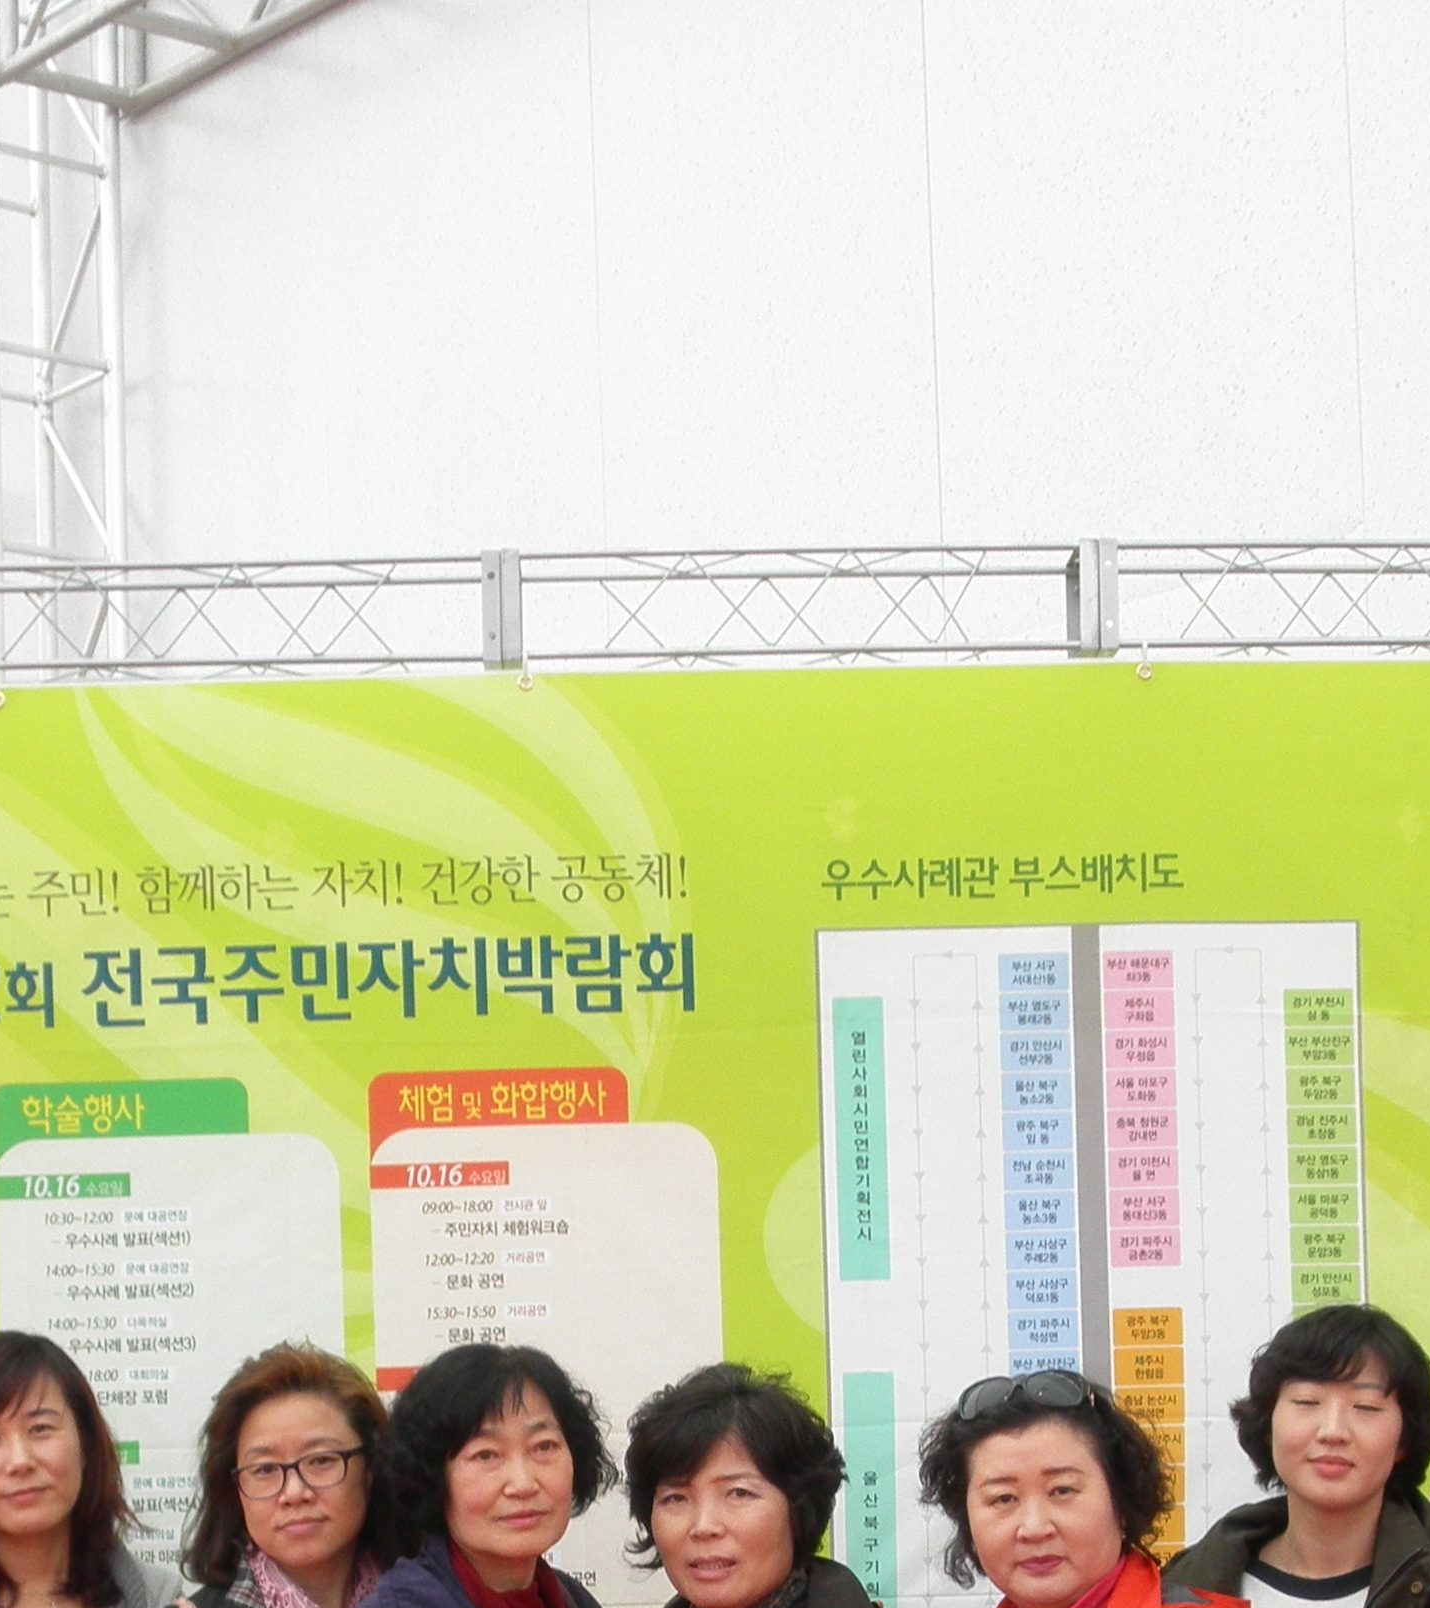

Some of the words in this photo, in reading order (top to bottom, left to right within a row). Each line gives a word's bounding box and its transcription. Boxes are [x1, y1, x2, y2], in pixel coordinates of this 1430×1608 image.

[821, 856, 999, 901] 우수사례관
[1010, 852, 1184, 897] 부스배치도
[27, 867, 119, 917] 주민!
[136, 862, 300, 915] 함께하는
[312, 859, 403, 907] 자치!
[421, 854, 540, 906] 건강한
[551, 852, 687, 903] 공동체!
[1012, 961, 1032, 972] 부산
[1036, 960, 1055, 971] 서구
[1107, 959, 1126, 970] 부산
[1130, 958, 1170, 969] 해운대구
[81, 932, 695, 1028] 전국주민자치박람회
[1008, 1001, 1028, 1012] 부산
[1293, 998, 1312, 1008] 경기
[1010, 1041, 1028, 1052] 경기
[1115, 1038, 1133, 1049] 경기
[1138, 1038, 1167, 1049] 화성시
[1289, 1037, 1308, 1047] 부산
[1015, 1081, 1034, 1092] 울산
[1038, 1080, 1058, 1092] 북구
[1115, 1078, 1134, 1088] 서울
[399, 1084, 453, 1122] 체험
[462, 1091, 482, 1119] 및
[491, 1079, 607, 1119] 화합행사
[22, 1093, 145, 1134] 학술행사
[1016, 1121, 1035, 1132] 광주
[1040, 1120, 1059, 1131] 북구
[1012, 1161, 1032, 1172] 전남
[1036, 1160, 1065, 1171] 순천시
[1118, 1158, 1137, 1168] 경기
[1296, 1155, 1316, 1166] 부산
[406, 1165, 462, 1187] 10.16
[469, 1170, 506, 1185] 수요일
[24, 1176, 80, 1198] 10.16
[86, 1181, 122, 1195] 수요일
[422, 1200, 493, 1214] 09:00~18:00
[504, 1200, 533, 1211] 전시관
[1018, 1201, 1038, 1212] 울산
[1042, 1200, 1061, 1211] 북구
[1123, 1197, 1142, 1208] 부산
[1147, 1197, 1166, 1207] 서구
[44, 1212, 113, 1225] 10:30~12:00
[1022, 1213, 1058, 1224] 농소3동
[445, 1222, 498, 1237] 주민자치
[503, 1219, 569, 1236] 체험워크숍
[66, 1233, 118, 1248] 우수사례
[123, 1231, 191, 1247] 발표(섹션1)
[1014, 1240, 1034, 1251] 부산
[1038, 1239, 1067, 1250] 사상구
[1120, 1237, 1138, 1248] 경기
[1142, 1236, 1172, 1247] 파주시
[1326, 1234, 1345, 1244] 북구
[425, 1252, 494, 1266] 12:00~12:20
[506, 1252, 545, 1264] 거리공연
[46, 1264, 115, 1277] 14:00~15:30
[446, 1275, 472, 1290] 문화
[478, 1273, 505, 1289] 공연
[1300, 1274, 1319, 1284] 경기
[1323, 1273, 1352, 1283] 안산시
[1016, 1280, 1034, 1291] 부산
[1039, 1279, 1068, 1289] 사상구
[67, 1285, 120, 1300] 우수사례
[125, 1283, 194, 1299] 발표(섹션2)
[428, 1306, 496, 1320] 15:30~15:50
[507, 1304, 547, 1316] 거리공연
[48, 1317, 116, 1330] 14:00~15:30
[1017, 1320, 1036, 1330] 경기
[1040, 1319, 1070, 1329] 파주시
[1127, 1317, 1146, 1327] 광주
[1150, 1316, 1169, 1326] 북구
[448, 1328, 474, 1343] 문화
[480, 1327, 506, 1342] 공연
[70, 1338, 121, 1354] 우수사례
[127, 1336, 196, 1352] 발표(섹션3)
[1013, 1359, 1033, 1370] 부산
[1135, 1356, 1164, 1366] 제주시
[142, 1390, 168, 1404] 포럼
